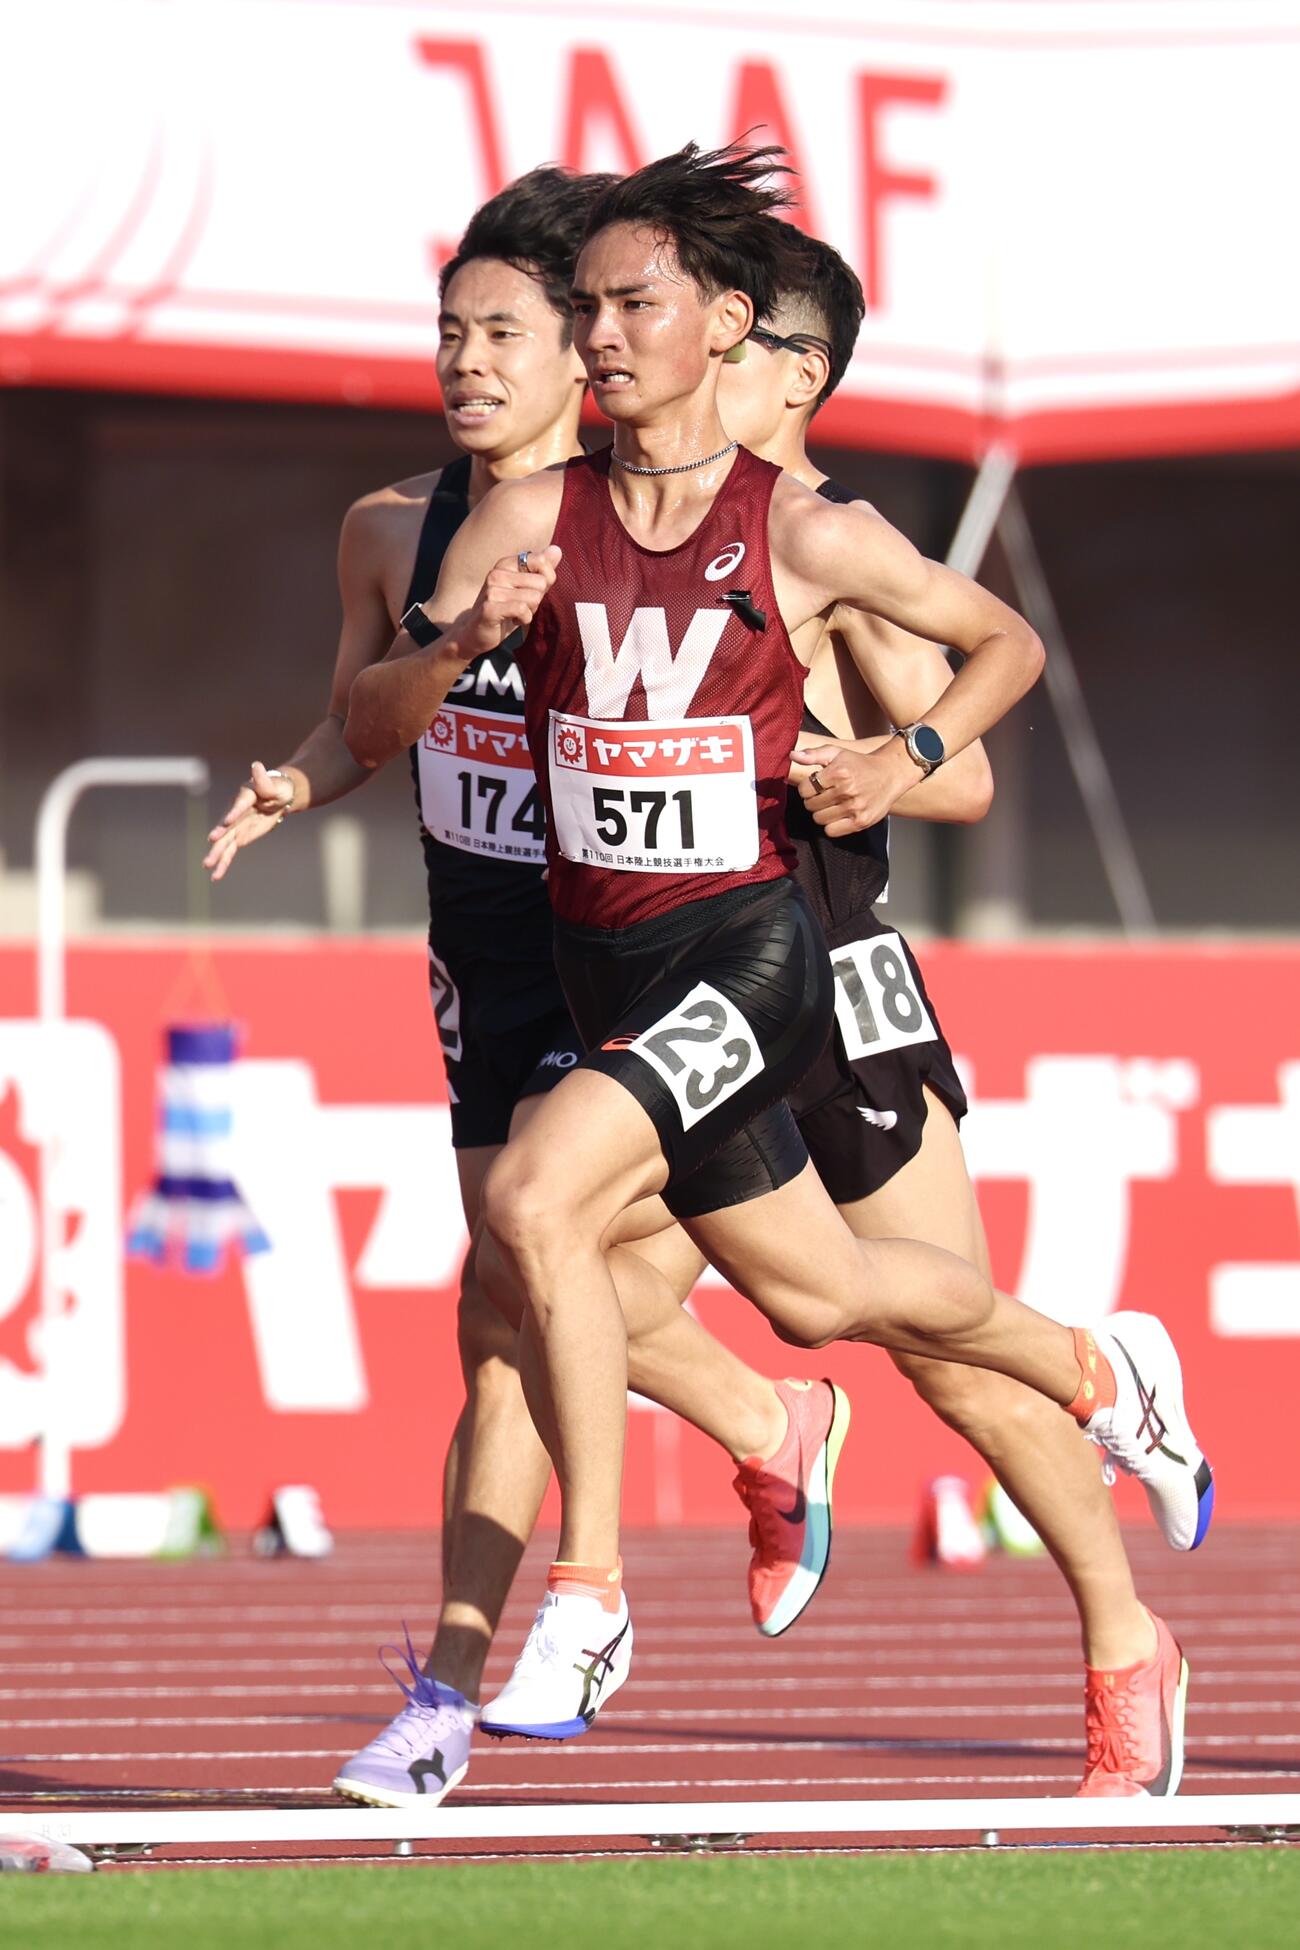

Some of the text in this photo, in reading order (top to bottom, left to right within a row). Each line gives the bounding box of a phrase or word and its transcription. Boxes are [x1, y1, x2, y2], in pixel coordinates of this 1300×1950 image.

[575, 602, 732, 720] W
[592, 736, 734, 767] ヤマザキ
[458, 771, 546, 841] 174
[592, 787, 695, 849] 571
[582, 848, 725, 868] 第110回 日本陸上競技選手権大会
[833, 944, 923, 1045] 18
[642, 1000, 752, 1110] 23
